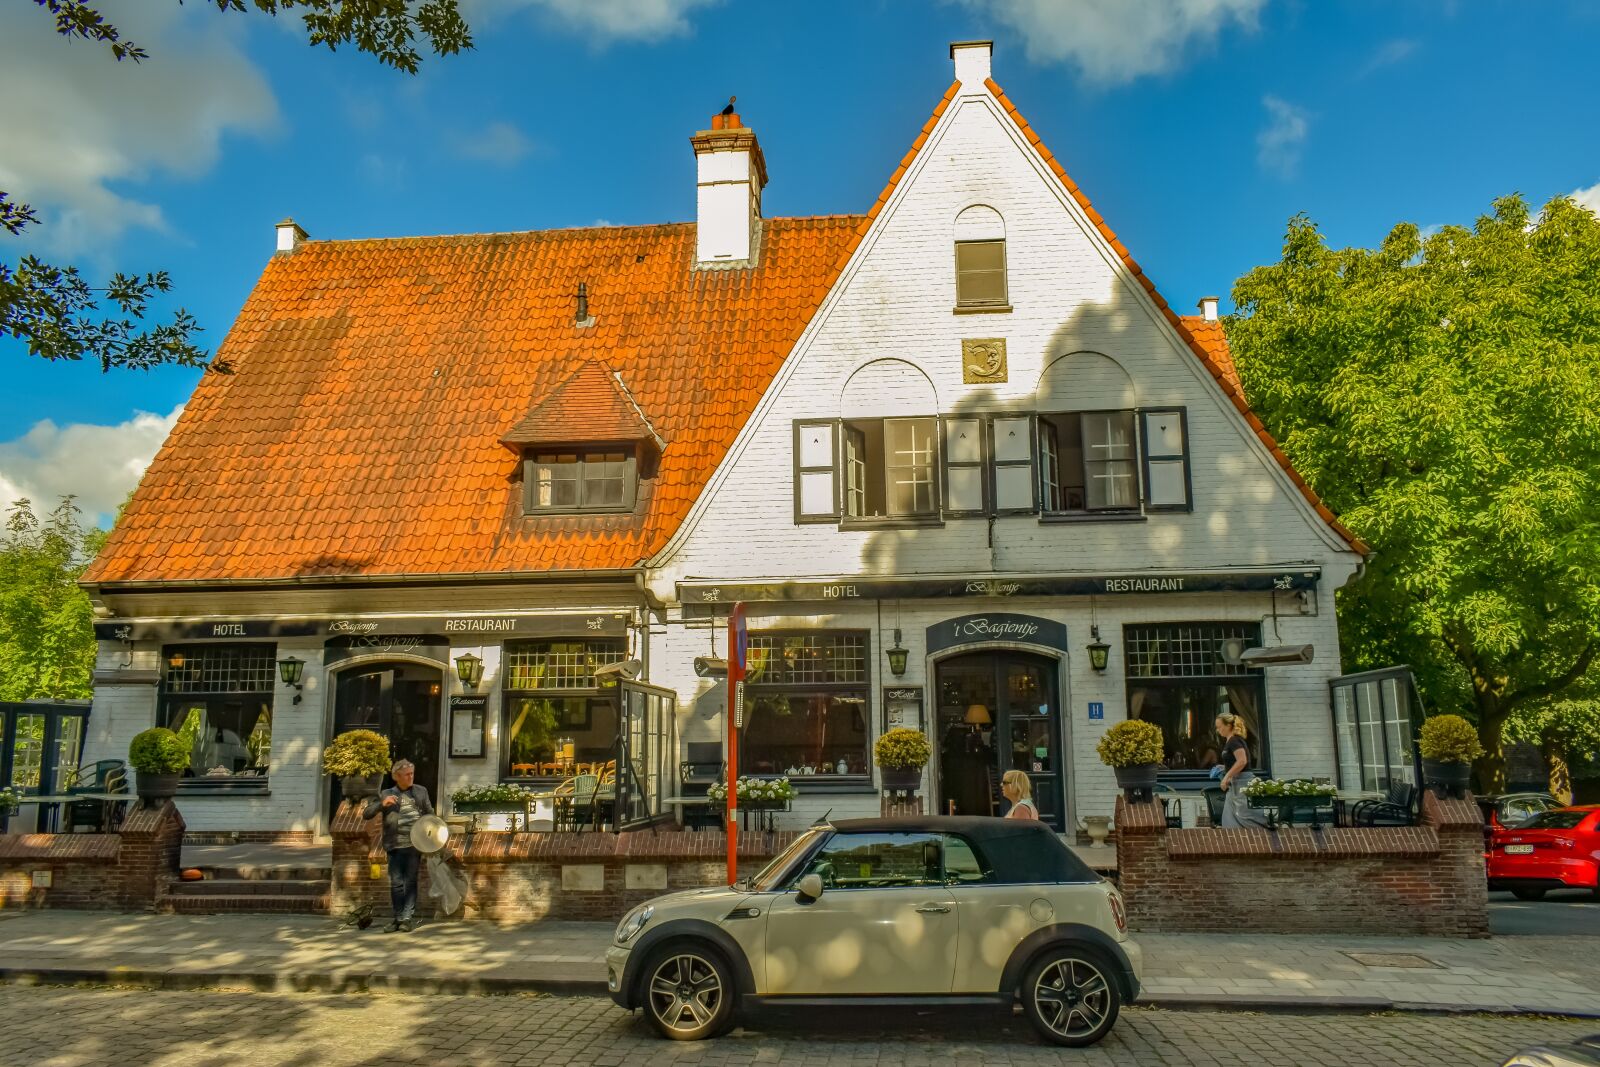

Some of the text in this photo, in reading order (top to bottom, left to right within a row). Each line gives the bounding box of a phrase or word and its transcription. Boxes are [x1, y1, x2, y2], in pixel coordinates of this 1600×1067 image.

[823, 585, 860, 597] HOTEL
[968, 581, 1021, 596] Baientje
[1105, 578, 1184, 592] RESTAURANT
[213, 623, 247, 636] HOTEL
[333, 620, 379, 633] Bagientje
[445, 618, 517, 631] RESTAURANT
[953, 618, 1039, 639] 't Bagientje
[357, 634, 424, 652] Bagientje
[888, 689, 916, 699] Hotel
[450, 697, 485, 706] Restaurant
